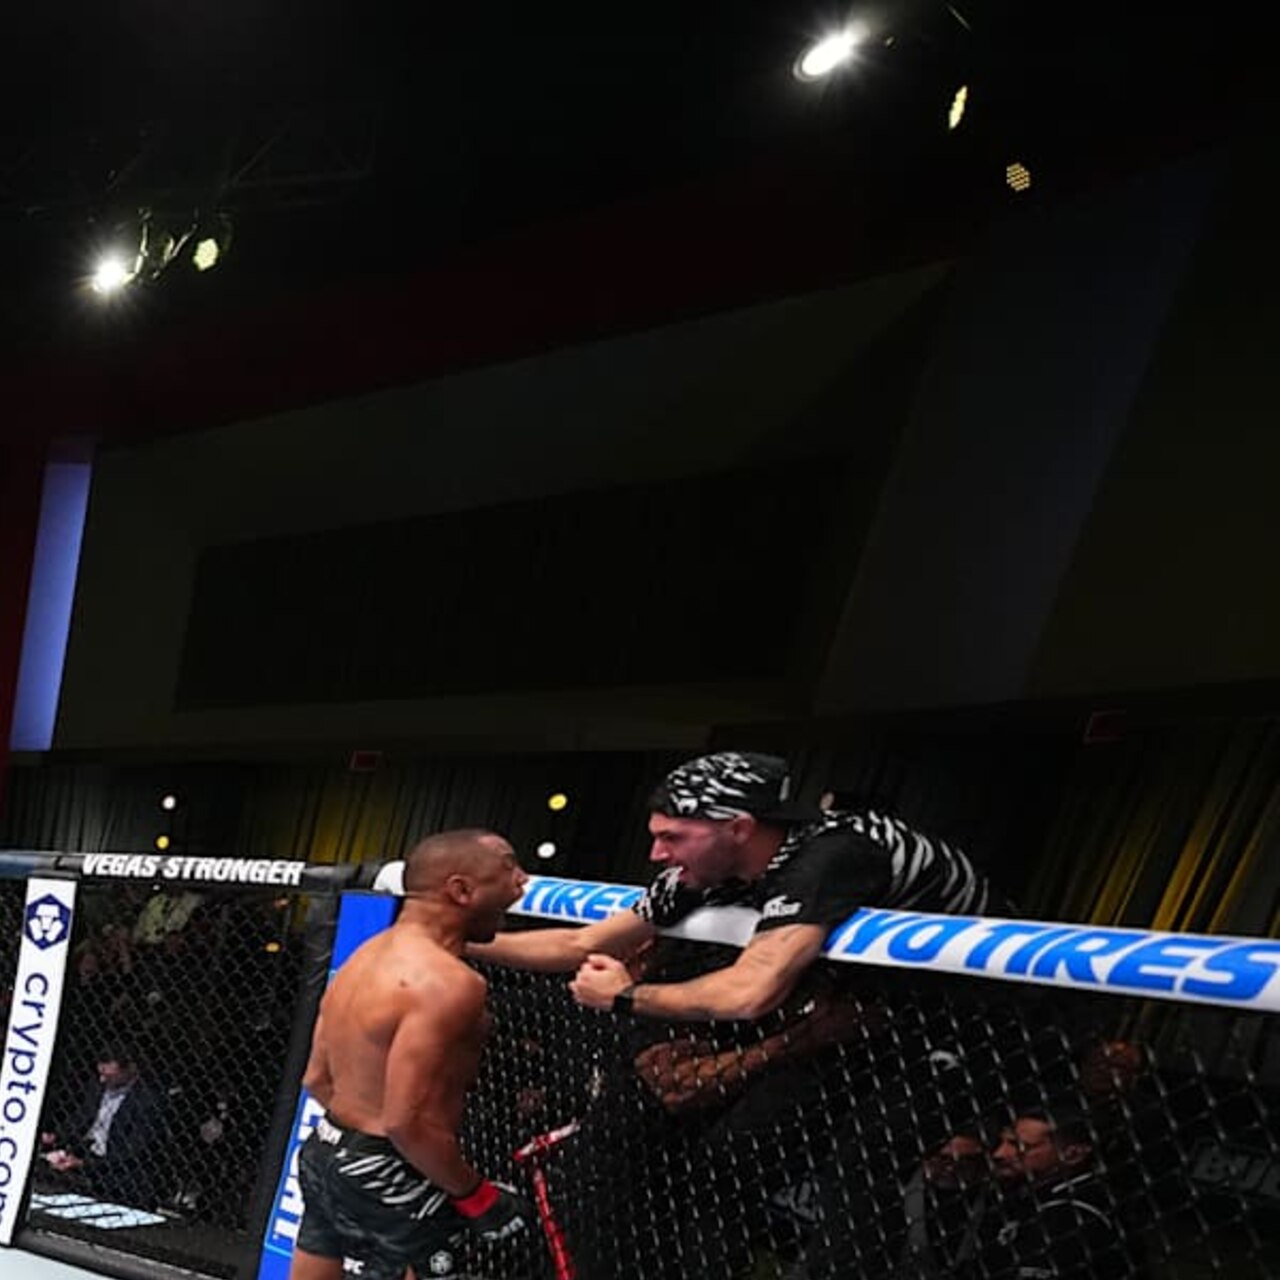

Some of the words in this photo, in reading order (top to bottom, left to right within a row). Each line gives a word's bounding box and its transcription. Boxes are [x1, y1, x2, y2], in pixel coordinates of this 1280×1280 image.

[81, 853, 158, 881] VEGAS
[162, 855, 305, 887] STRONGER
[964, 922, 1280, 1000] TIRES
